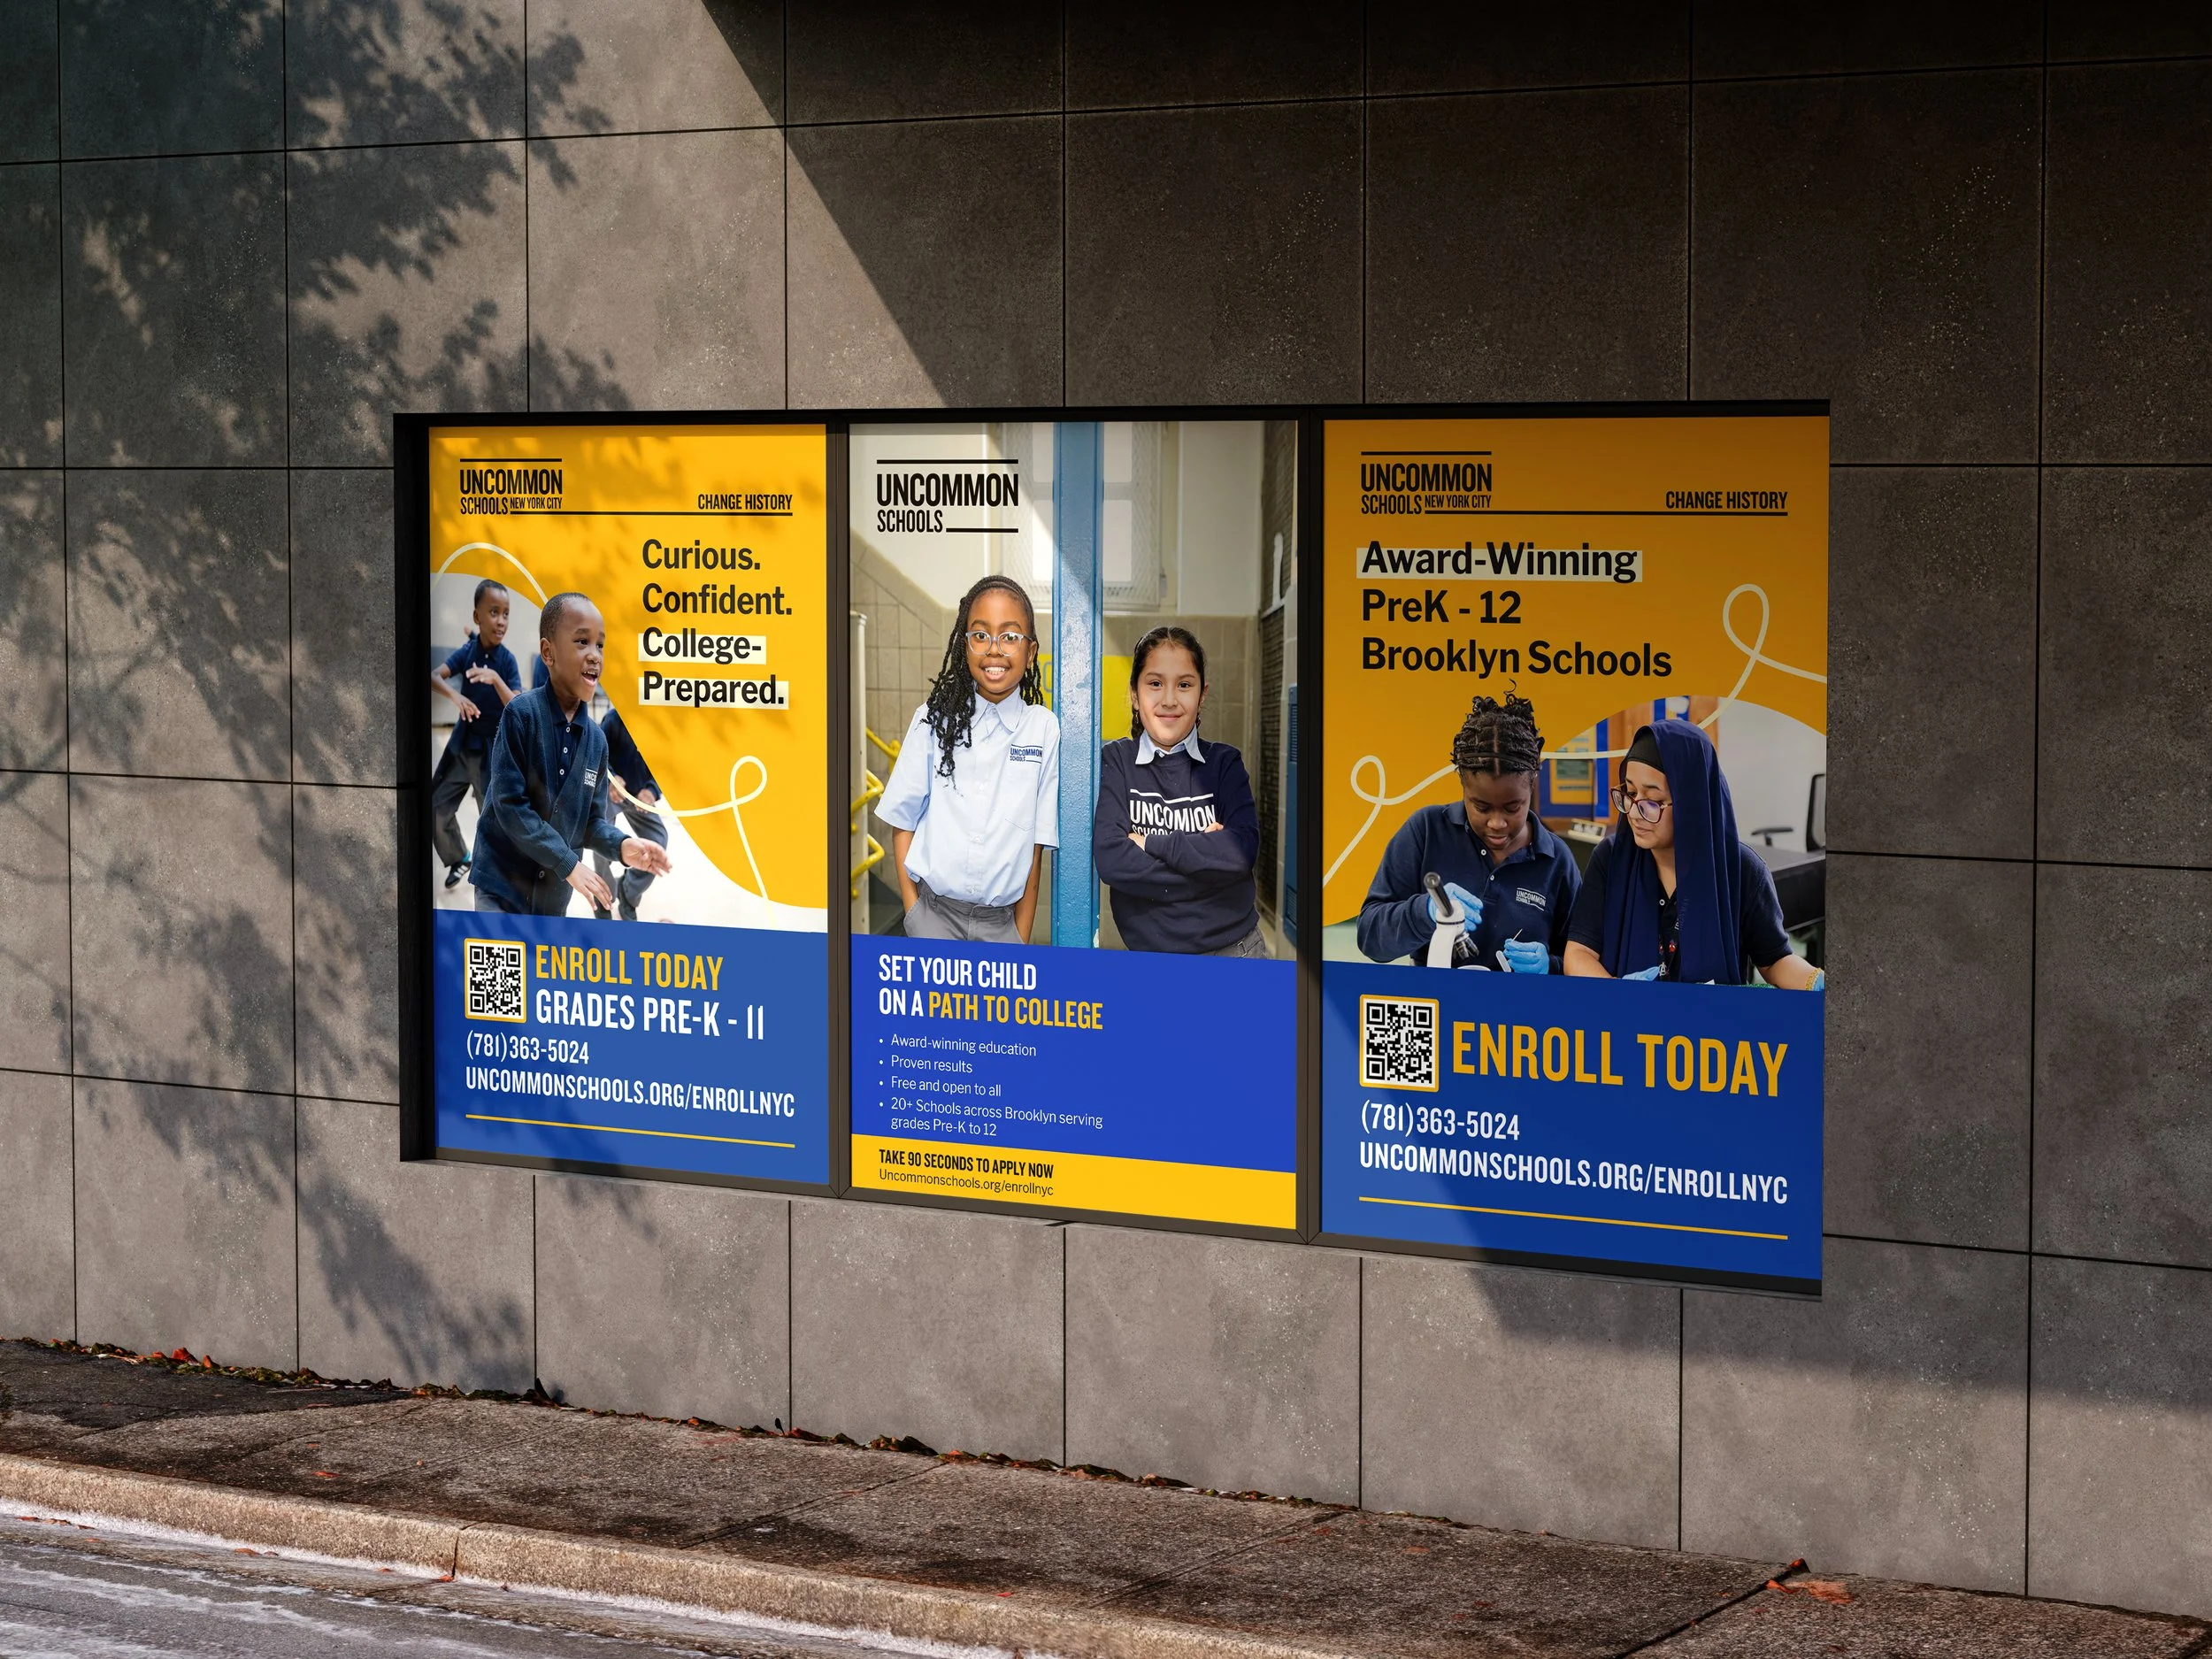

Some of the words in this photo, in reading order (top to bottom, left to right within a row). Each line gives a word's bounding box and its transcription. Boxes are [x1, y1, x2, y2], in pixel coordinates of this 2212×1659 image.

[460, 469, 562, 495] UNCOMMON
[877, 473, 1018, 507] UNCOMMON
[1362, 463, 1492, 492] UNCOMMON
[461, 497, 508, 515] SCHOOLS
[511, 497, 526, 509] NEW
[526, 497, 545, 509] YORK
[547, 497, 562, 509] CITY
[698, 494, 741, 510] CHANGE
[745, 494, 792, 510] HISTORY
[1362, 495, 1422, 514] SCHOOLS
[1425, 495, 1444, 508] NEW
[1447, 495, 1470, 508] YORK
[1471, 495, 1491, 508] CITY
[1666, 491, 1723, 509] CHANGE
[1727, 491, 1787, 509] HISTORY
[878, 510, 942, 533] SCHOOLS
[642, 539, 760, 570] Curious.
[1362, 541, 1637, 584] Award-Winning
[643, 583, 792, 615] Confident.
[1363, 589, 1449, 622] PreK
[1480, 591, 1521, 624] 12
[643, 626, 761, 664] College-
[1363, 637, 1519, 679] Brooklyn
[1528, 641, 1671, 677] Schools
[644, 671, 784, 708] Prepared.
[1010, 748, 1043, 757] UNCOMMON
[536, 945, 632, 984] ENROLL
[640, 952, 723, 990] TODAY
[879, 955, 915, 982] SET
[919, 957, 972, 986] YOUR
[979, 961, 1036, 990] CHILD
[536, 989, 634, 1030] GRADES
[644, 997, 719, 1036] PRE-K
[748, 1005, 763, 1040] 11
[879, 988, 905, 1015] ON
[911, 991, 924, 1017] A
[929, 992, 978, 1020] PATH
[984, 995, 1009, 1023] TO
[1015, 997, 1102, 1029] COLLEGE
[467, 1030, 589, 1064] (781)363-5024
[891, 1033, 976, 1054] Award-winning
[979, 1041, 1036, 1056] education
[1454, 1021, 1623, 1085] ENROLL
[1637, 1033, 1788, 1096] TODAY
[892, 1055, 931, 1070] Proven
[934, 1060, 972, 1073] results
[466, 1067, 794, 1117] UNCOMMONSCHOOLS.ORG/ENROLLNYC
[892, 1076, 916, 1089] Free
[919, 1079, 939, 1091] and
[942, 1083, 971, 1094] open
[974, 1083, 986, 1095] to
[989, 1085, 1001, 1096] all
[891, 1118, 930, 1130] grades
[933, 1118, 965, 1133] Pre-K
[969, 1123, 980, 1134] to
[984, 1124, 996, 1136] 12
[892, 1097, 912, 1110] 20+
[917, 1099, 961, 1115] Schools
[964, 1106, 1002, 1118] across
[1005, 1107, 1056, 1124] Brooklyn
[1059, 1113, 1102, 1129] serving
[1362, 1100, 1519, 1140] (781)363-5024
[879, 1149, 905, 1165] TAKE
[908, 1152, 921, 1166] 90
[924, 1153, 973, 1171] SECONDS
[976, 1158, 989, 1172] TO
[992, 1160, 1025, 1176] APPLY
[1029, 1163, 1054, 1179] NOW
[1360, 1141, 1787, 1203] UNCOMMONSCHOOLS.ORG/ENROLLNYC
[879, 1169, 1054, 1197] Uncommonschools.org/enrollnyc
